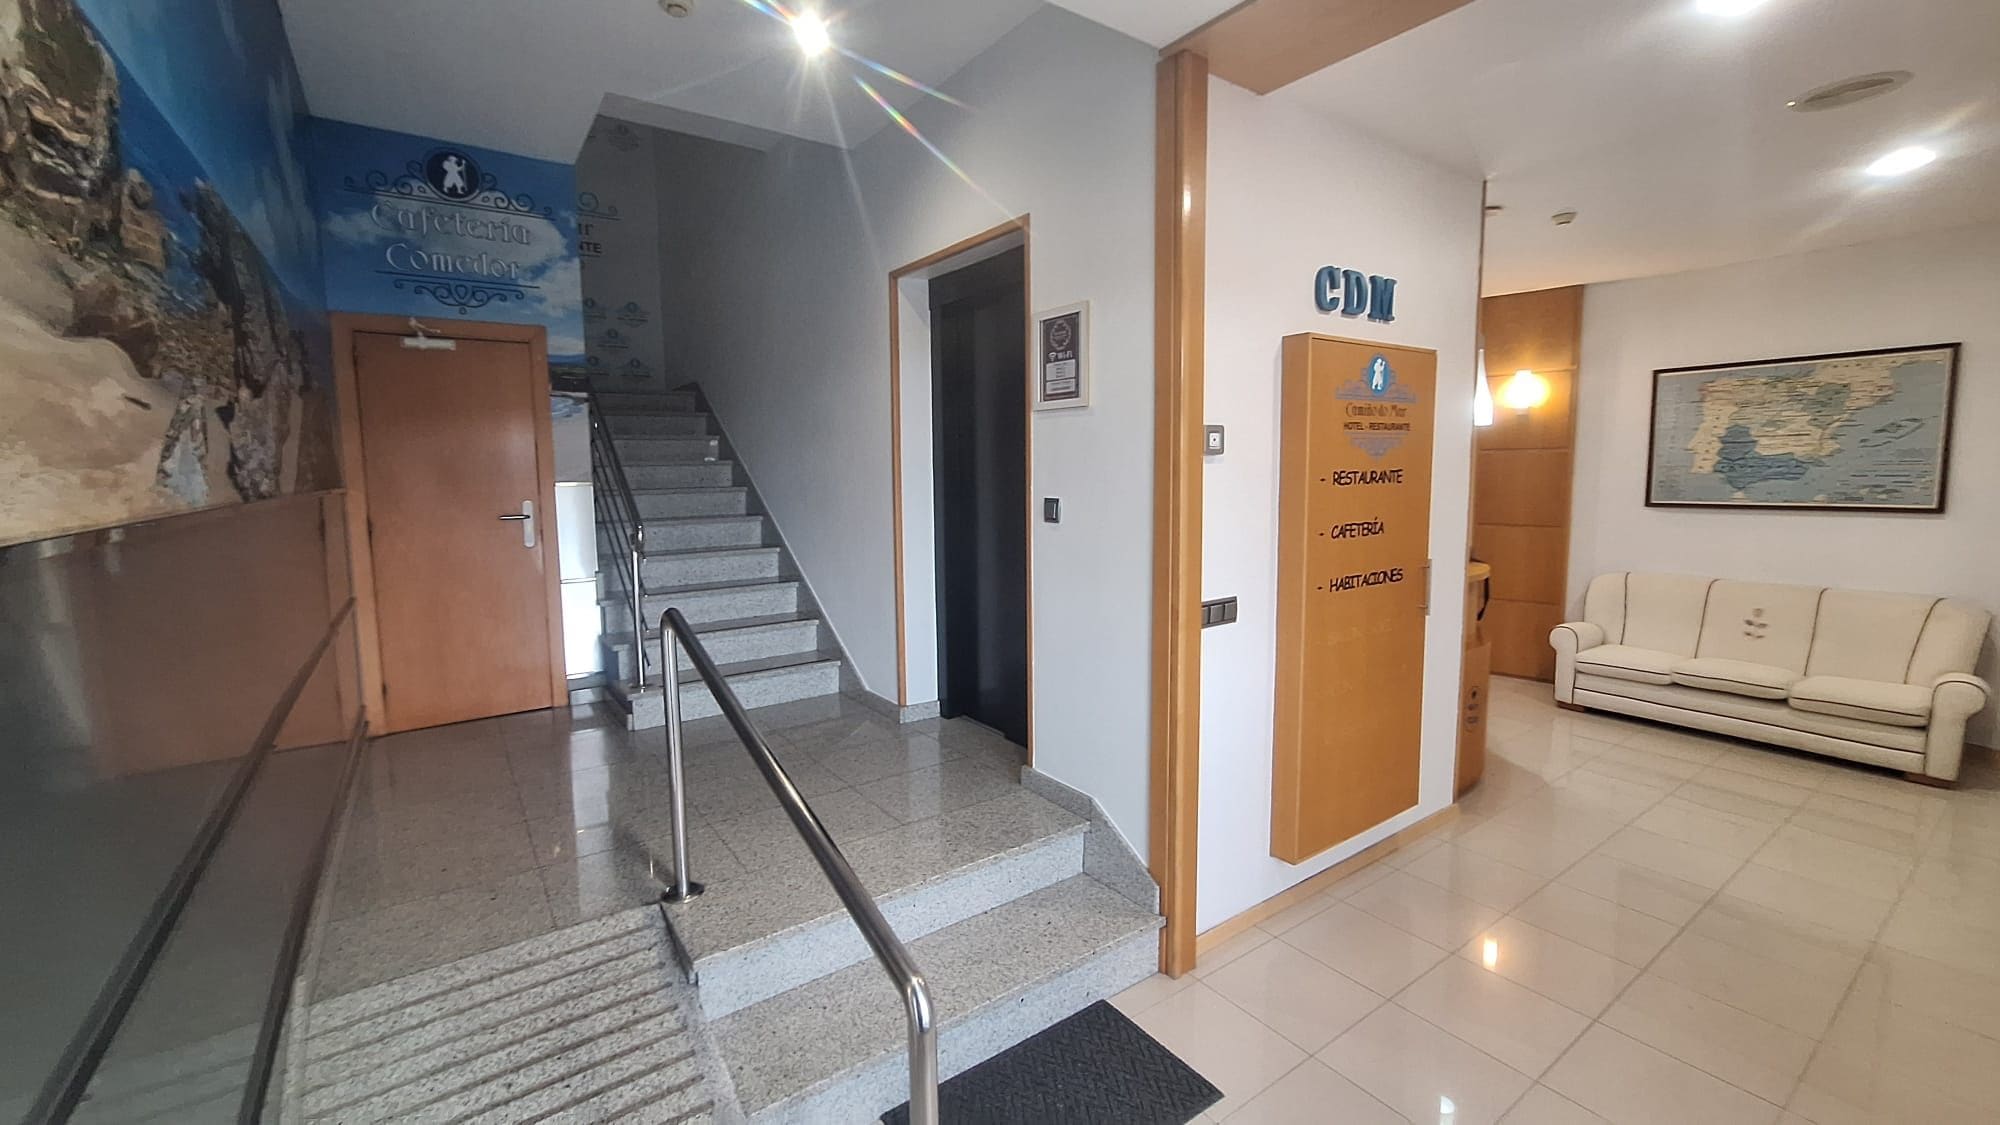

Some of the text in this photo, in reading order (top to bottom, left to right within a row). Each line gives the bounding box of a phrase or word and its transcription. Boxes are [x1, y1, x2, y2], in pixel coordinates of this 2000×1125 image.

[385, 242, 520, 279] Comedor
[1314, 264, 1398, 322] CDM
[1343, 421, 1365, 431] HOTEL
[1369, 422, 1411, 432] RESTAURANTE
[1332, 469, 1404, 486] RESTAURANTE
[1331, 516, 1385, 539] CAFETERÍA
[1329, 567, 1404, 593] HABITACIONES
